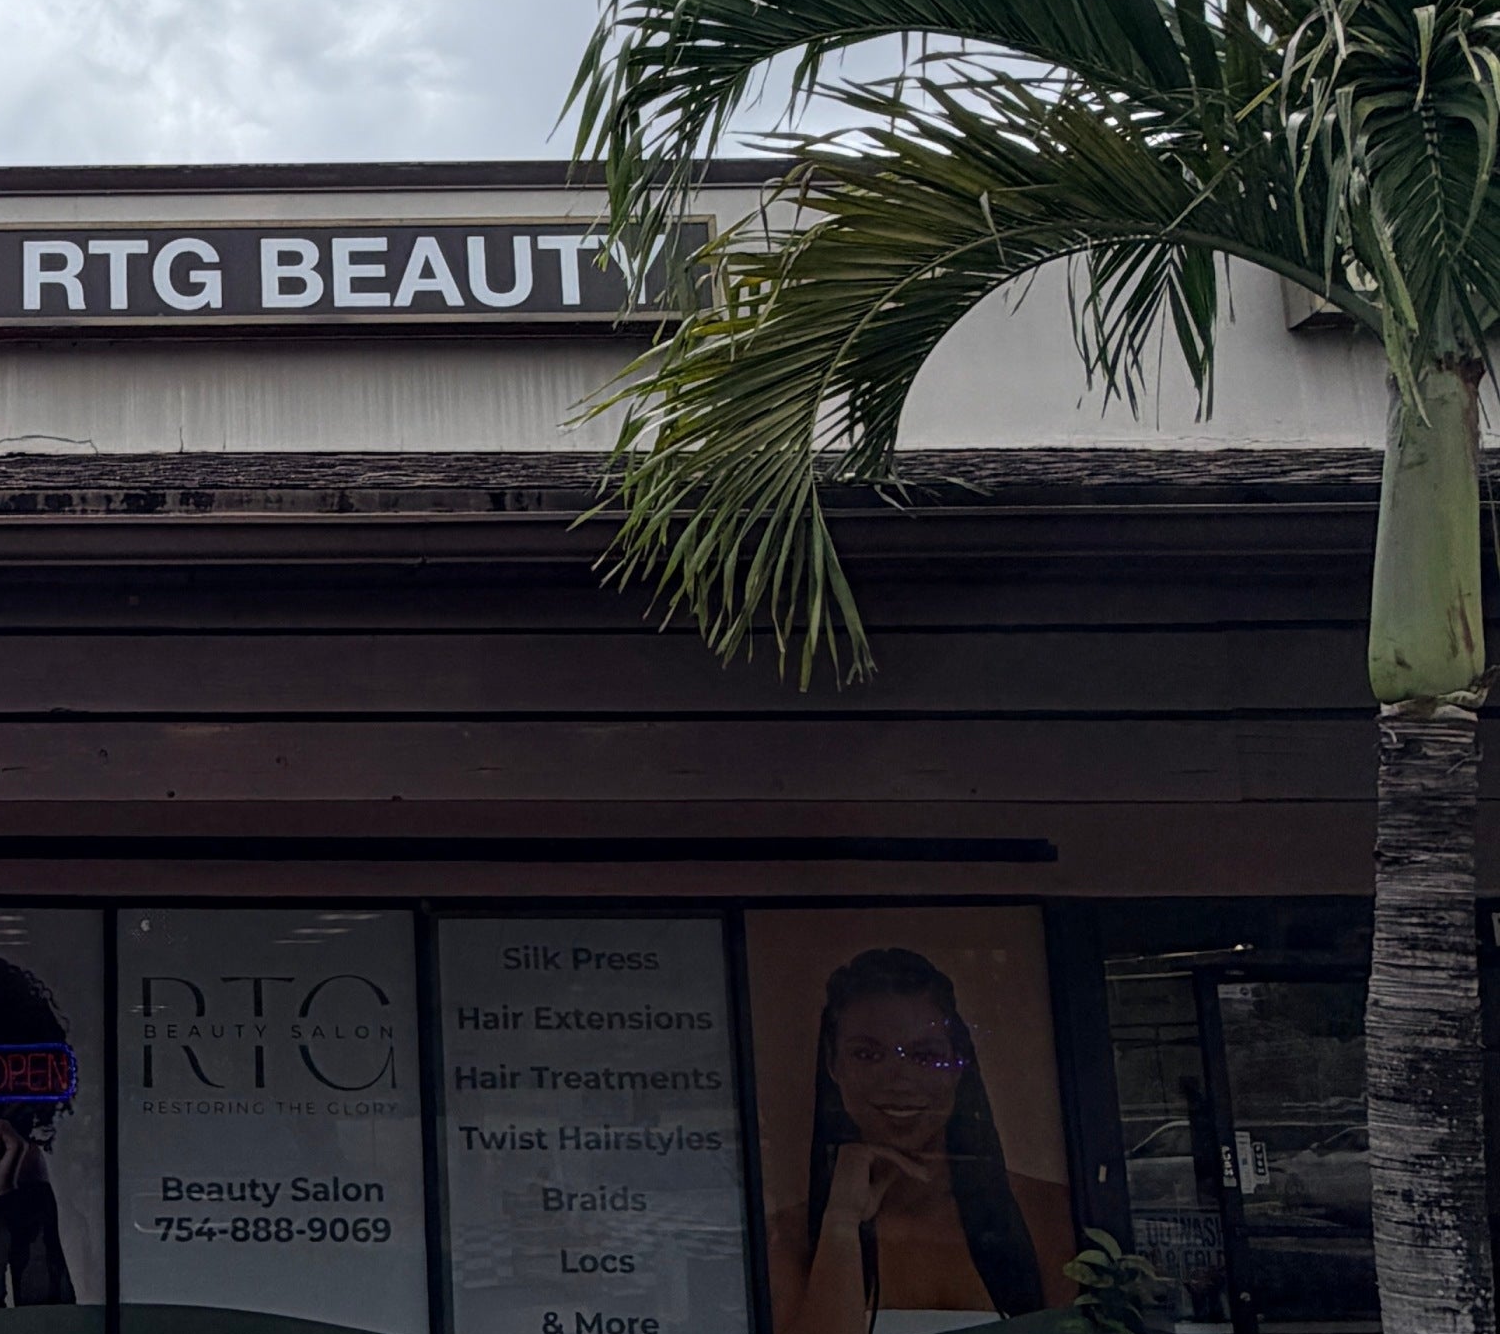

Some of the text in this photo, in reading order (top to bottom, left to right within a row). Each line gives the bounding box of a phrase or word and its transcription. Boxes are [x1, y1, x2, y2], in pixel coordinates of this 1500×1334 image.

[22, 234, 667, 311] RTG BEAUTY
[502, 945, 660, 971] Silk Press
[456, 1005, 714, 1031] Hair Extensions
[142, 974, 397, 1092] RTG
[143, 1024, 394, 1040] BEAUTY SALON
[455, 1064, 723, 1091] Hair Treatments
[142, 1101, 400, 1116] RESTORING THE GLORY
[459, 1124, 723, 1157] Twist Hairstyles
[161, 1176, 385, 1208] Beauty Salon
[542, 1186, 648, 1213] Braids
[154, 1217, 392, 1243] 754-888-9069
[560, 1249, 636, 1275] Locs
